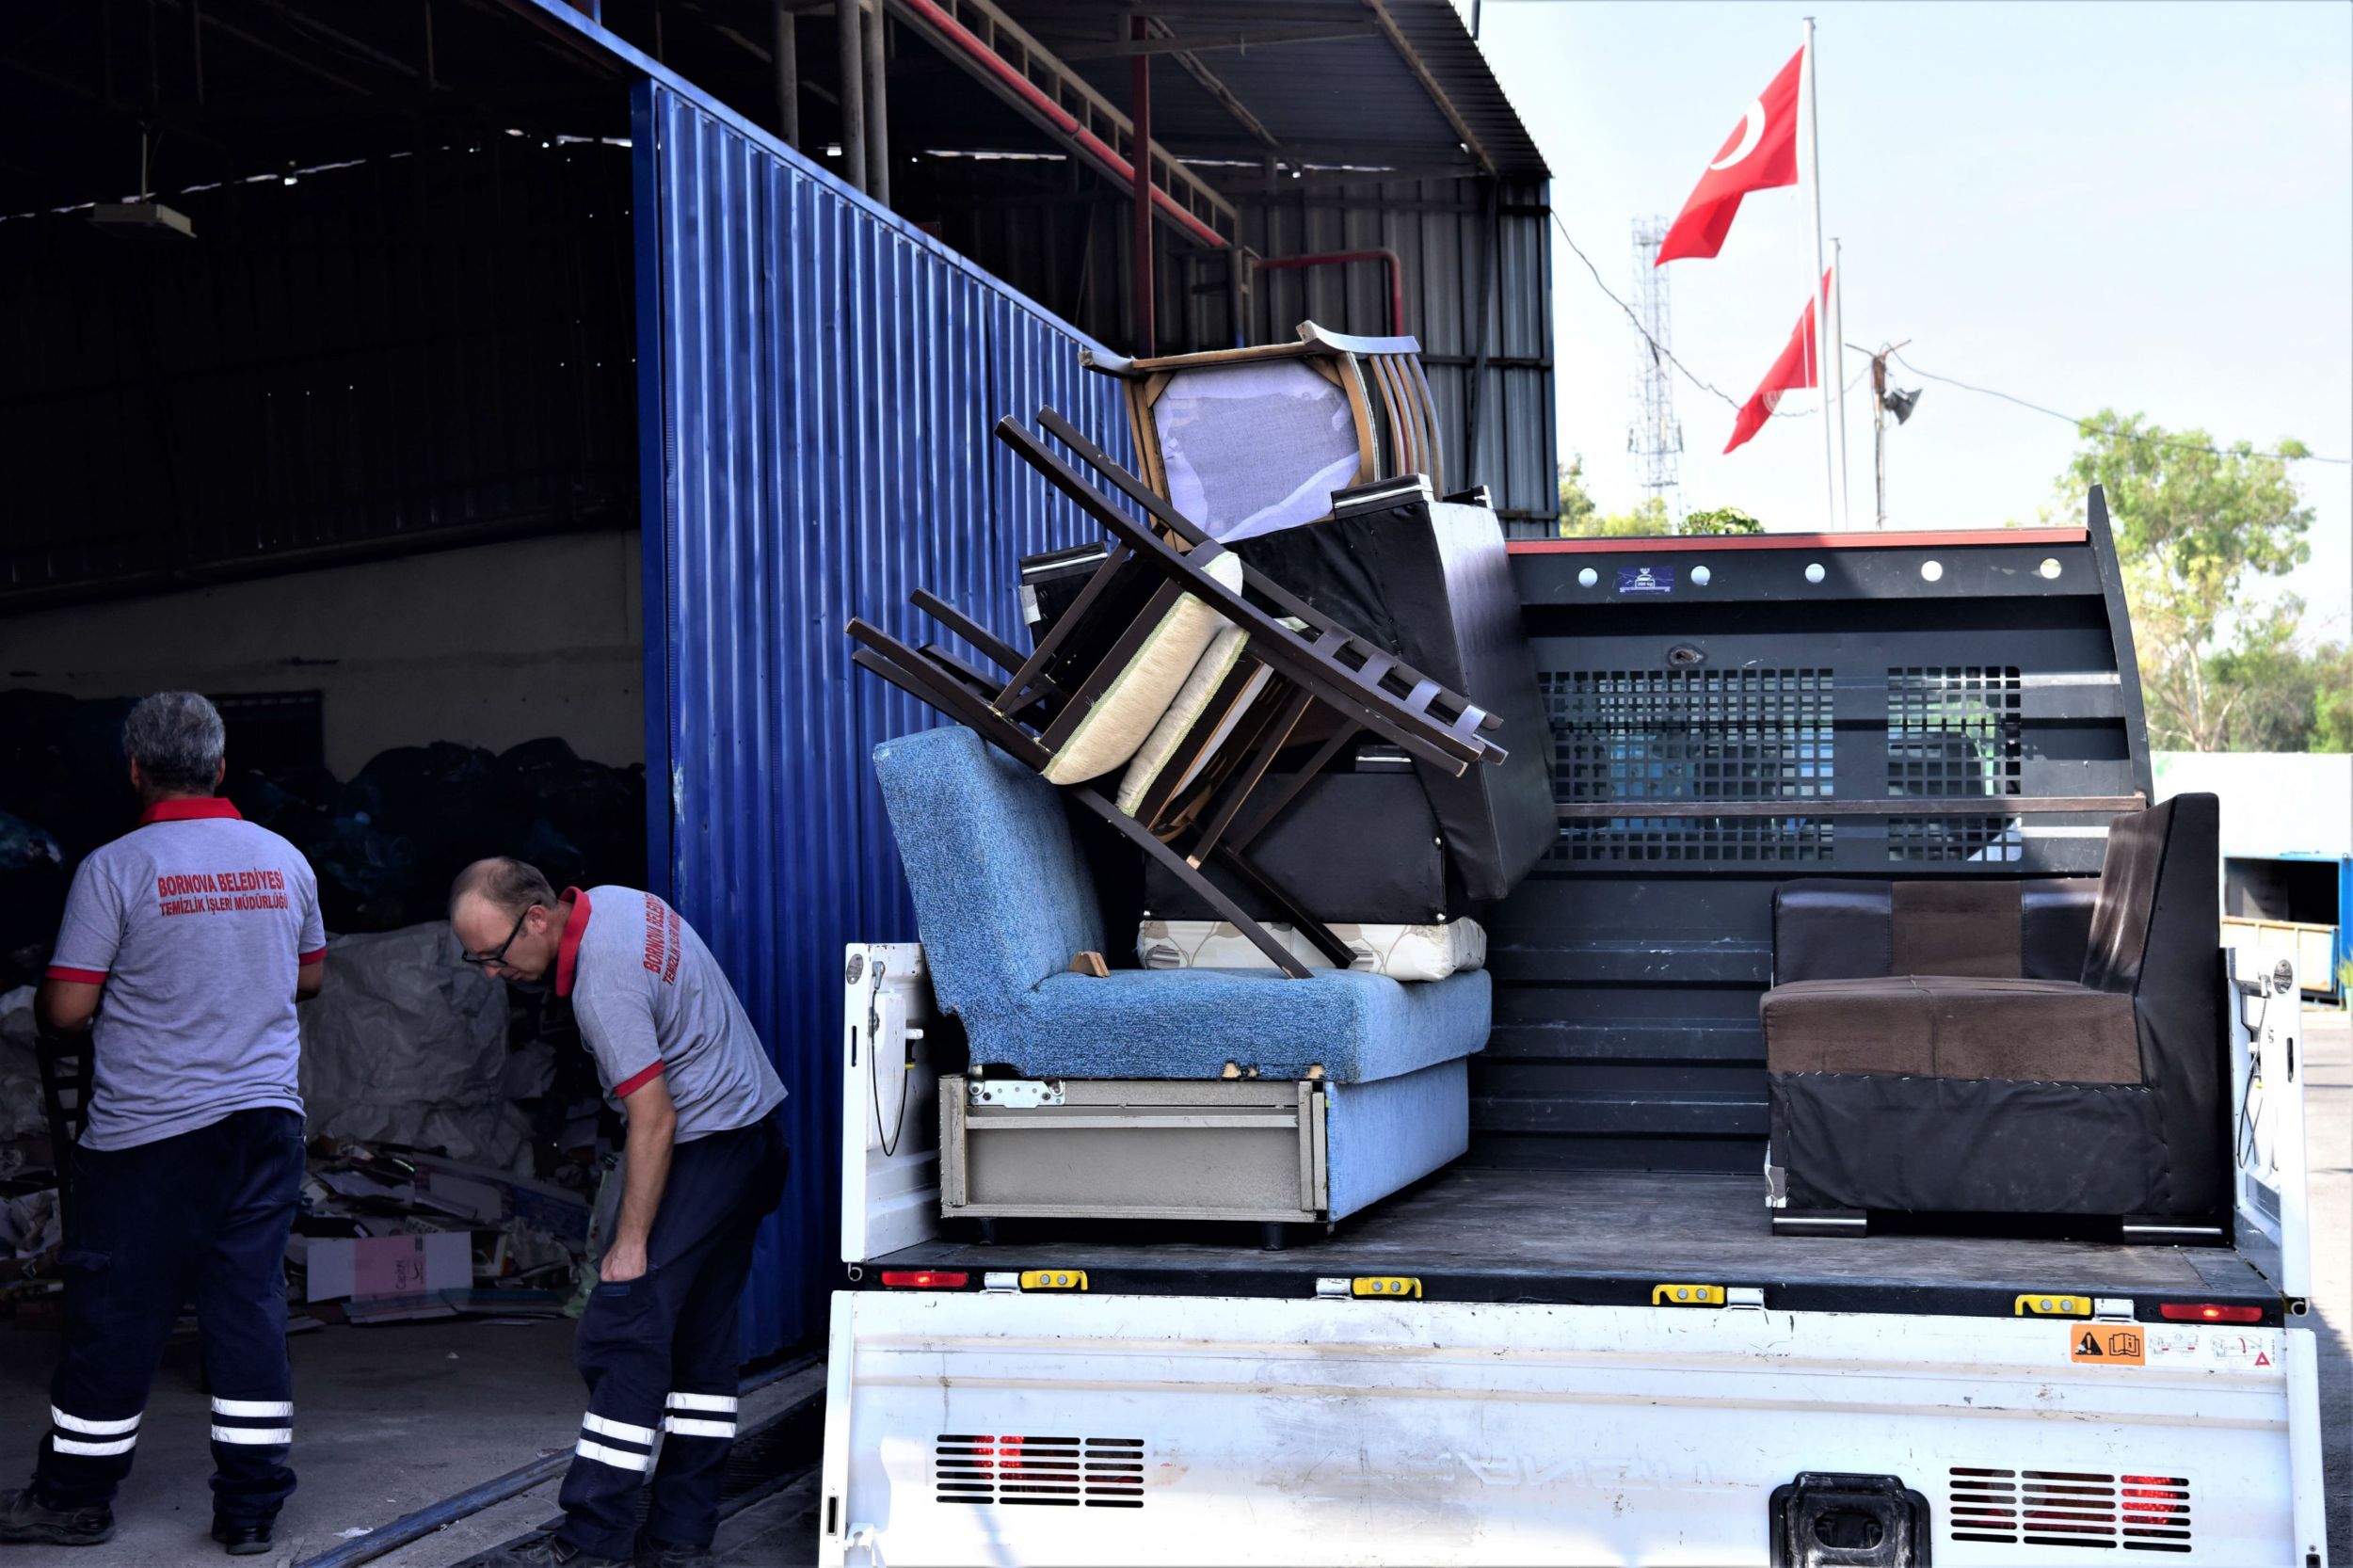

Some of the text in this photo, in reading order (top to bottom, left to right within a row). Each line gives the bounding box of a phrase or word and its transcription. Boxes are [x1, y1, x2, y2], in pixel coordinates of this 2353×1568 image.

[158, 867, 285, 897] BORNOVA BELEDİYESİ
[159, 896, 206, 917] TEMİZLİK
[205, 894, 232, 915] İŞLERİ
